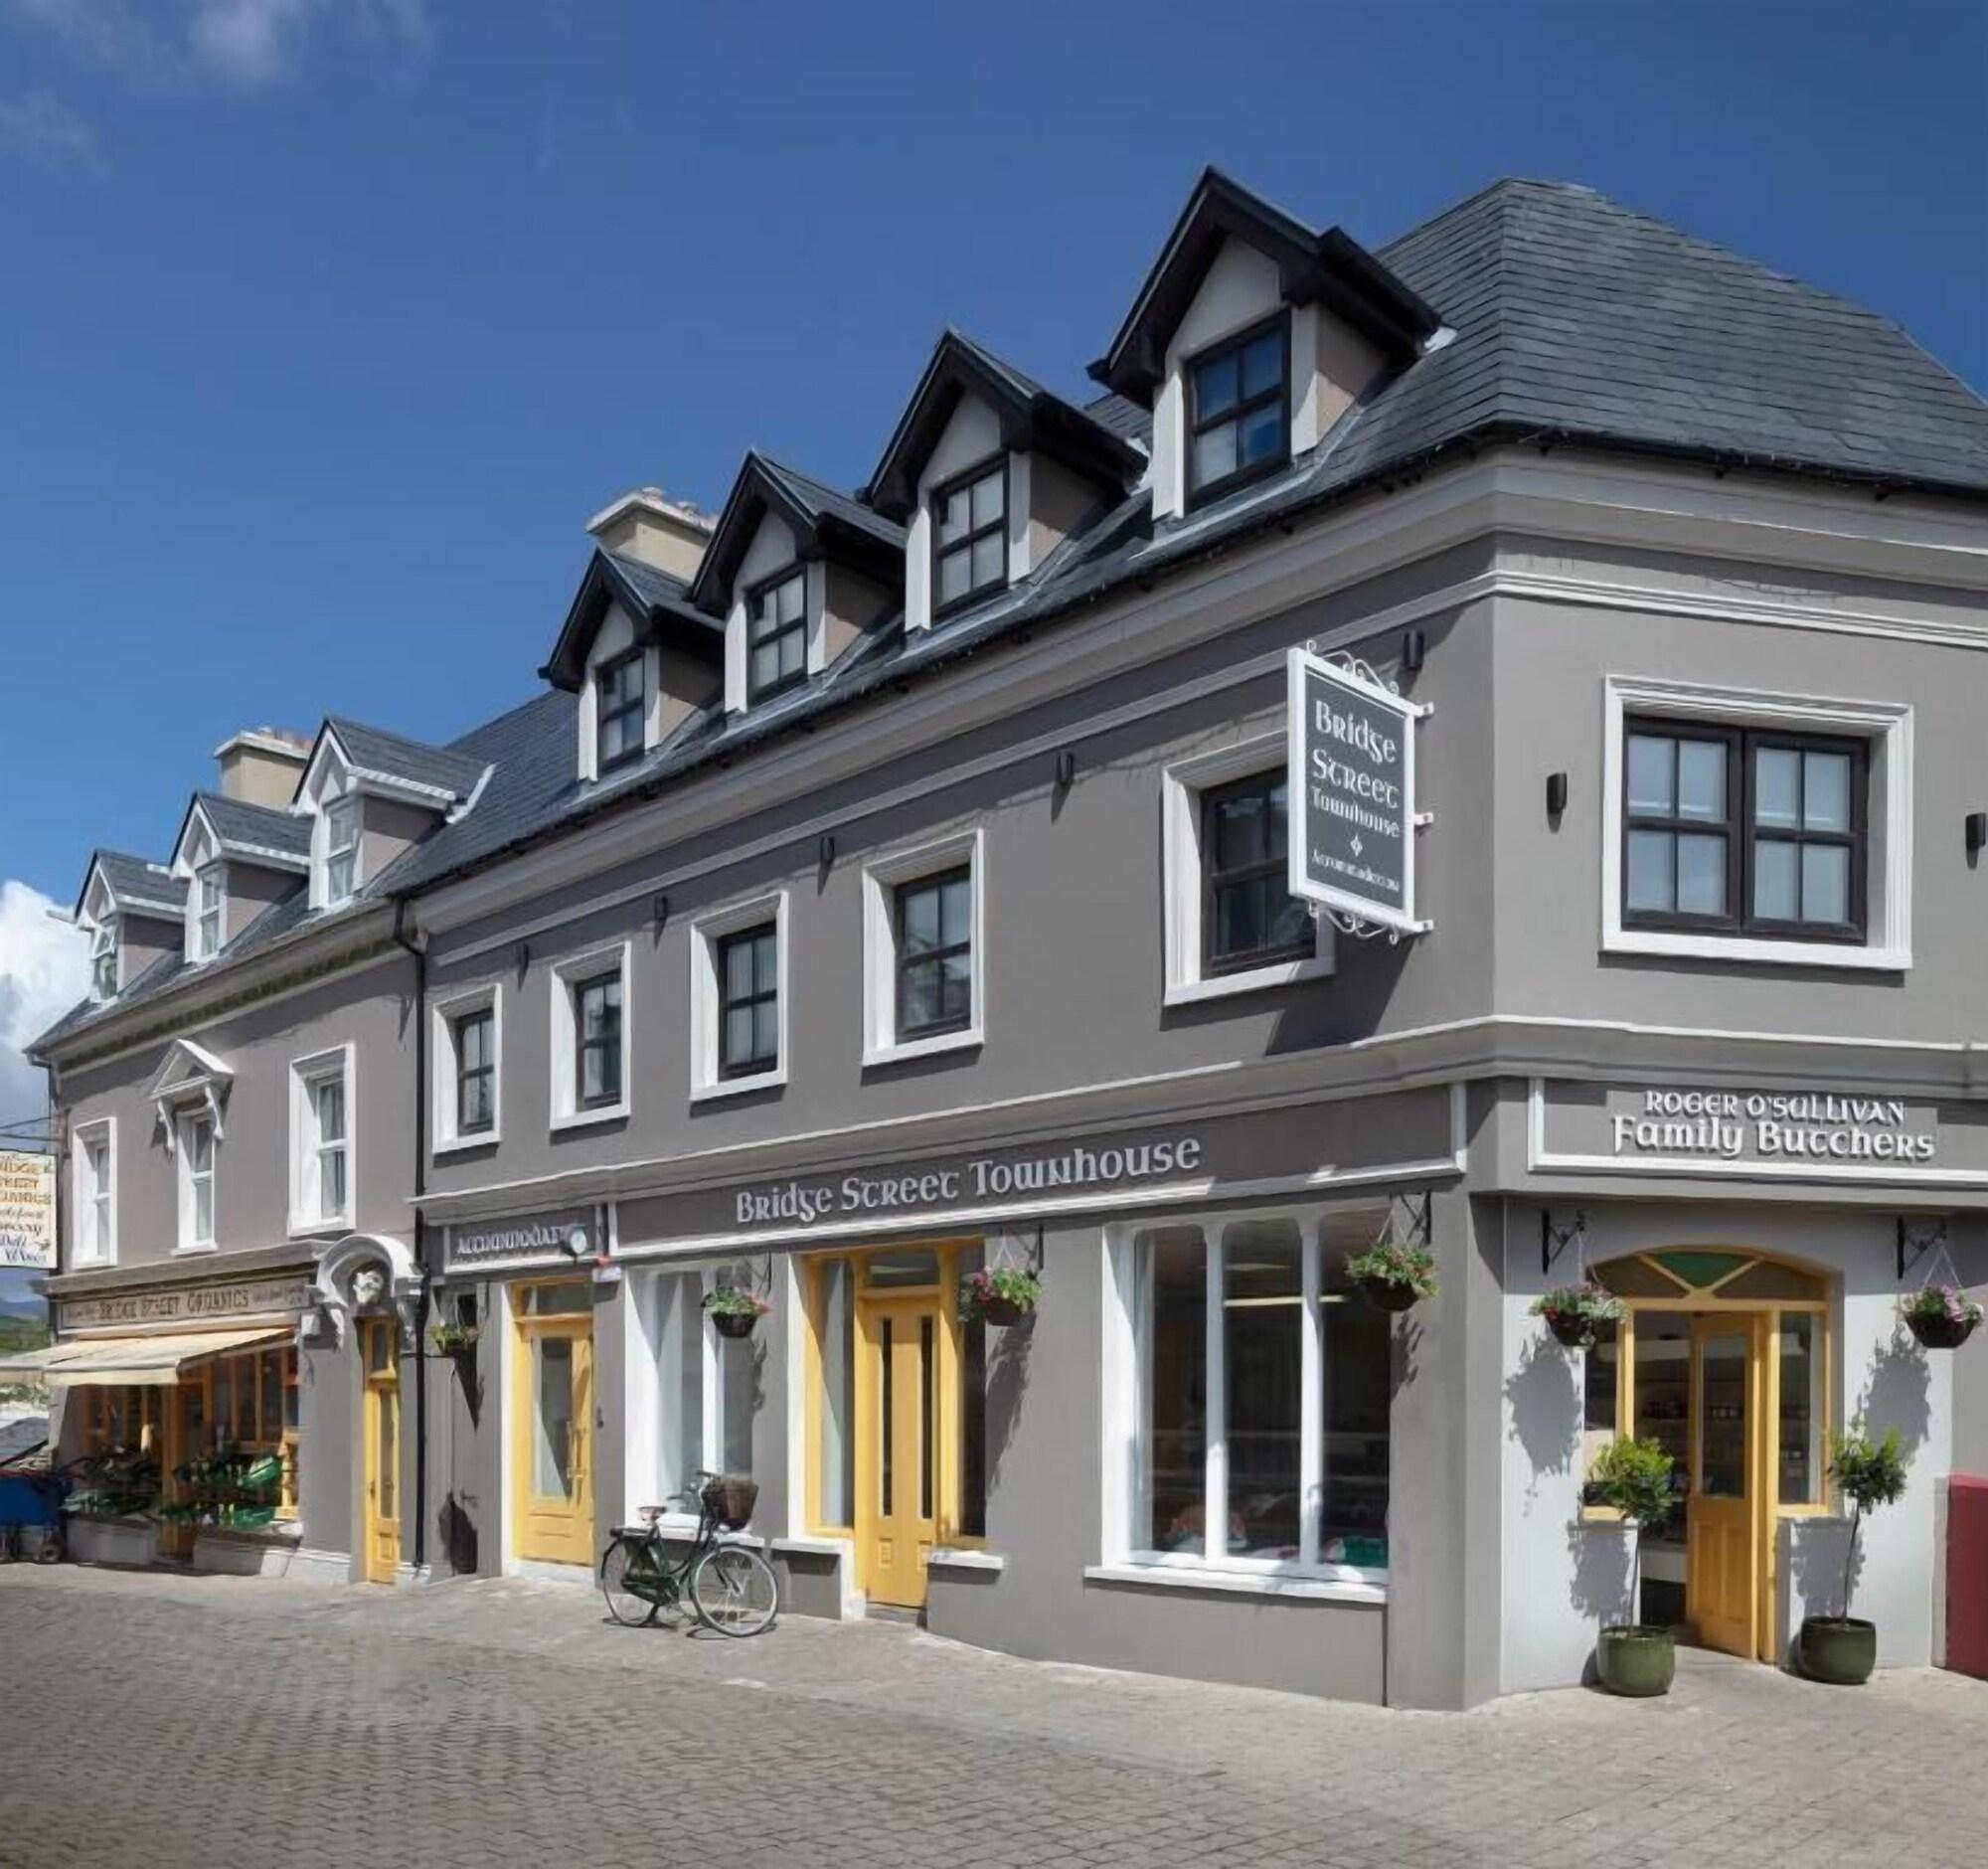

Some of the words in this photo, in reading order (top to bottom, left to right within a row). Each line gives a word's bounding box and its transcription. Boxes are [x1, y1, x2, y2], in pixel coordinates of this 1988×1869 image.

[1315, 700, 1397, 765] Bridge
[1311, 749, 1400, 809] Street
[1311, 786, 1401, 838] Townhouse
[1646, 1091, 1739, 1117] ROGER
[1612, 1115, 1743, 1157] Family
[1758, 1119, 1935, 1158] Butchers
[737, 1184, 833, 1223] Bridge
[841, 1171, 960, 1210] Street
[968, 1138, 1201, 1195] Townhouse
